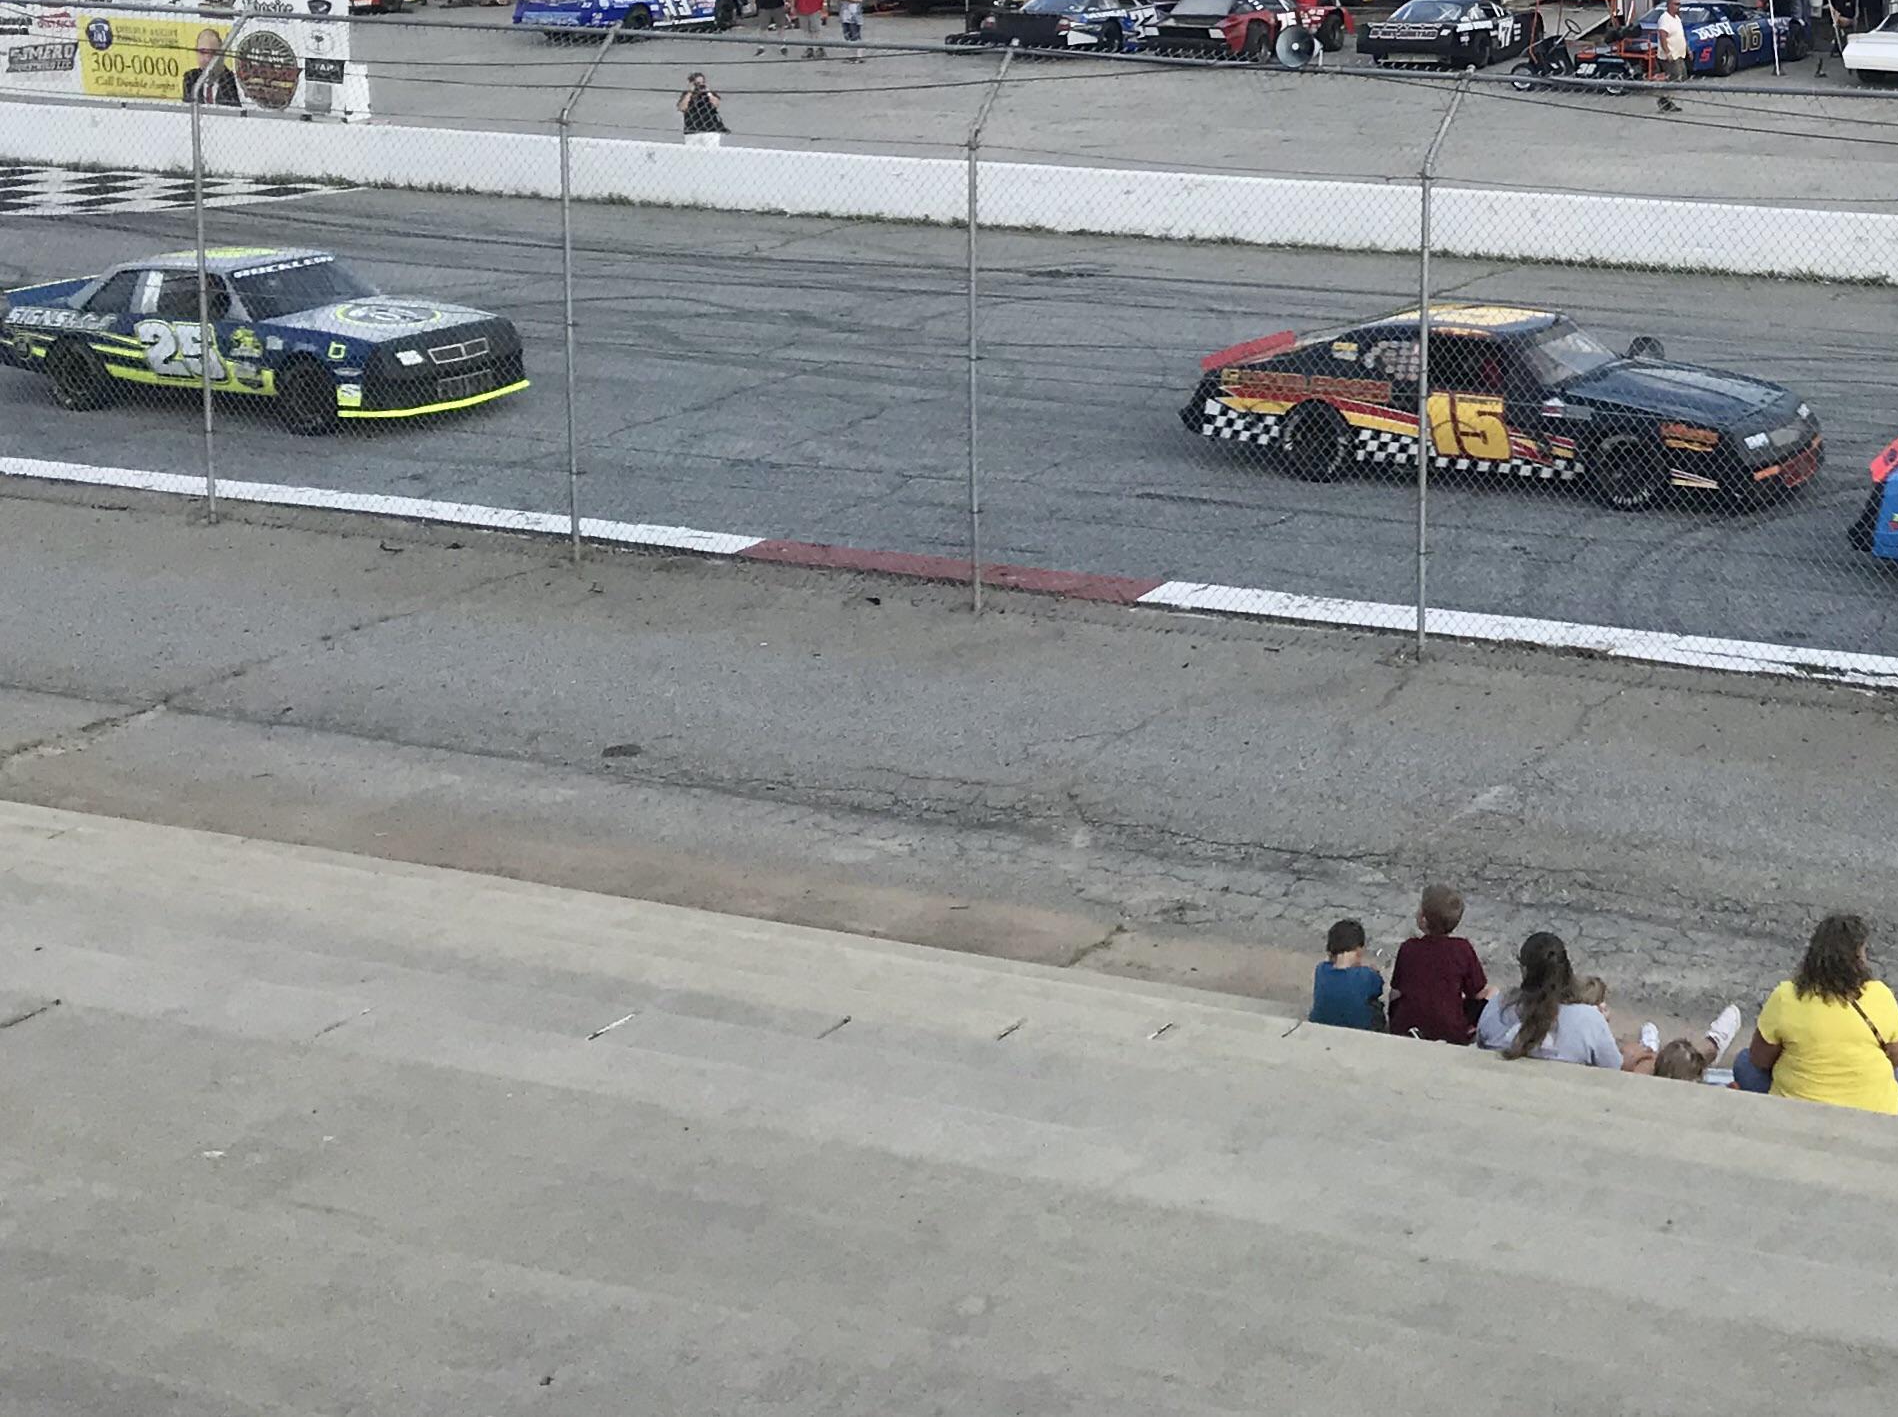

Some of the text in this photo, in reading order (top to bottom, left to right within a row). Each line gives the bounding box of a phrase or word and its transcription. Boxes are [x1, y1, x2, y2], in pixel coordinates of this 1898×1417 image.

[1692, 21, 1735, 40] BUSCH
[1737, 22, 1763, 53] 16
[91, 51, 179, 78] 300-0000
[134, 319, 228, 382] 25
[1426, 391, 1512, 461] 15
